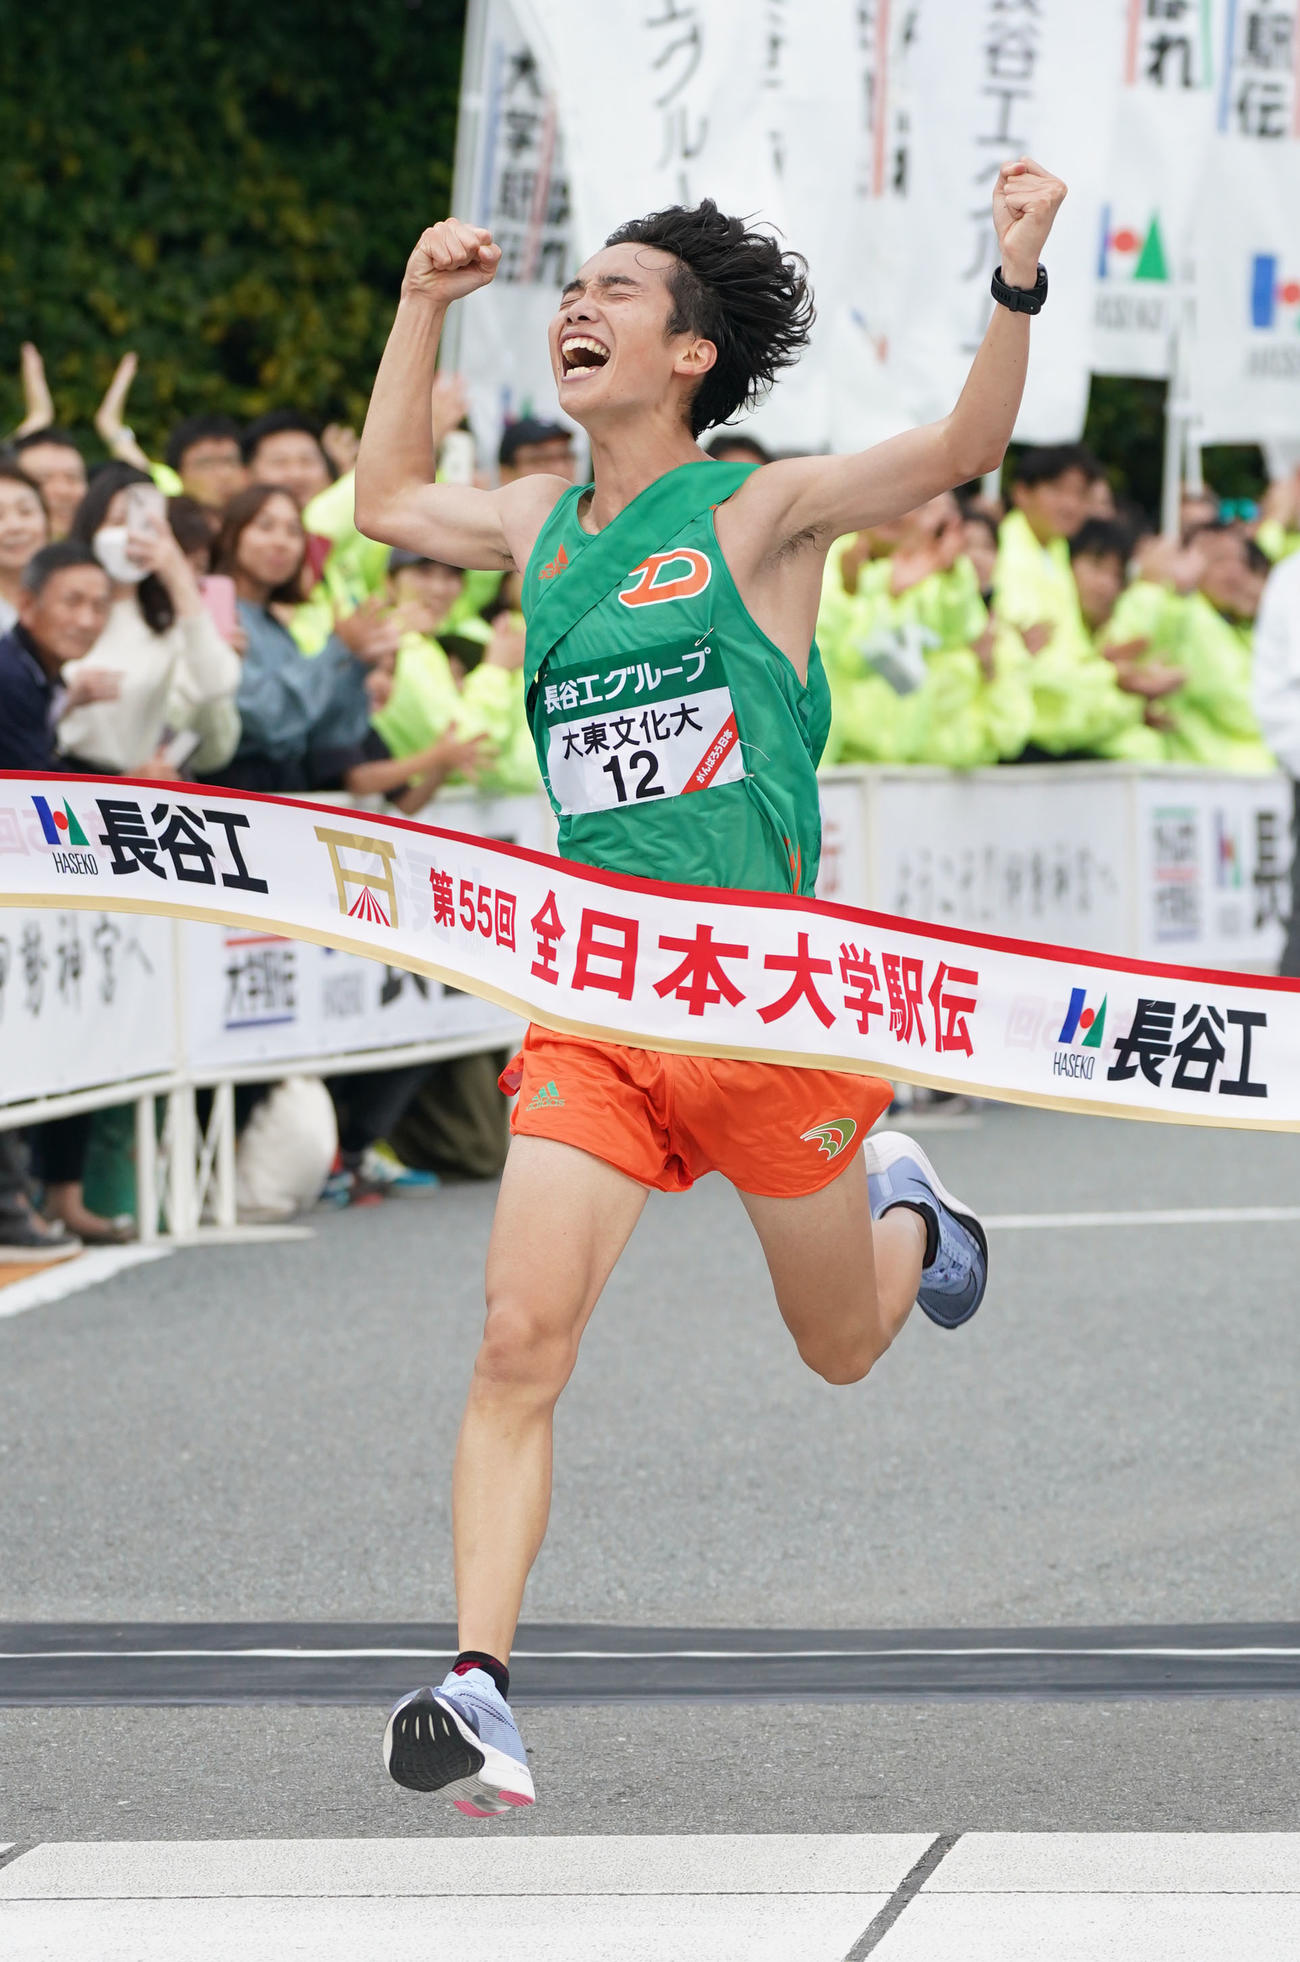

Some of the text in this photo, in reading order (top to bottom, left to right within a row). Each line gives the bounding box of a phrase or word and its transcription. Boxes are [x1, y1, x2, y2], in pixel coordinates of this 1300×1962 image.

[544, 647, 711, 714] 長谷工グループ
[562, 703, 703, 760] 大東文化大
[696, 729, 733, 784] がんばろう日本
[603, 750, 665, 802] 12
[53, 852, 98, 875] HASEKO
[95, 799, 269, 894] 長谷工
[429, 867, 517, 953] 第55回
[530, 889, 979, 1058] 全日本大学駅伝
[1053, 1052, 1095, 1080] HASEKO
[1107, 998, 1268, 1098] 長谷工
[526, 1096, 566, 1112] adidas
